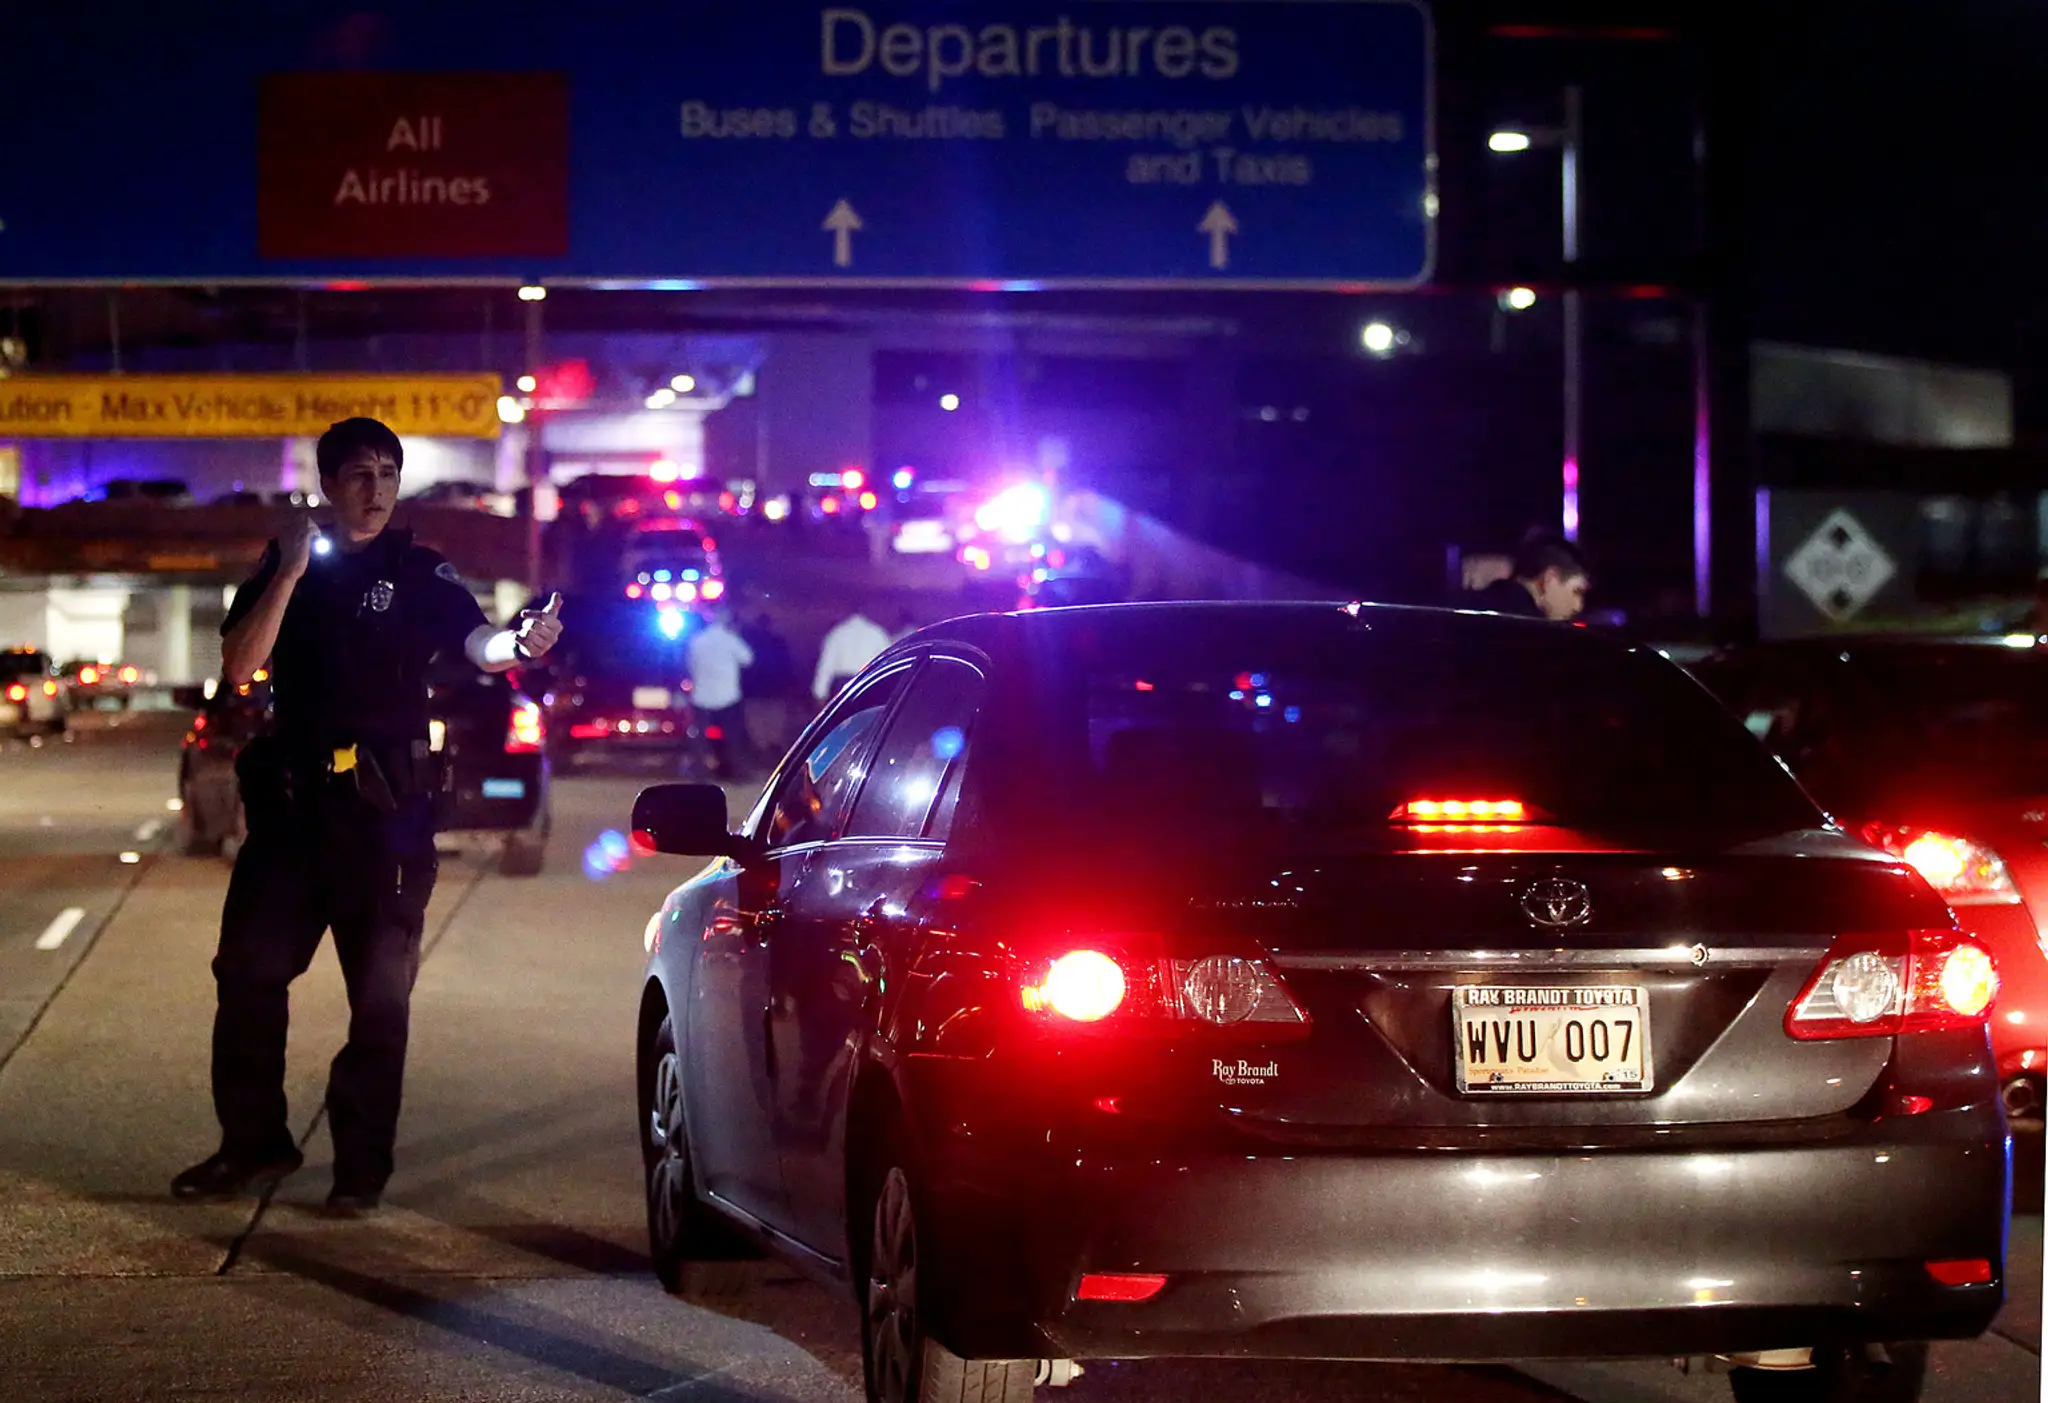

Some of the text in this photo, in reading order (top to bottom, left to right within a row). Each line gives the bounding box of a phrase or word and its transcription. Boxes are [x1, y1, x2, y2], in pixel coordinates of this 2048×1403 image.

[820, 8, 1240, 92] Departures
[386, 115, 442, 152] All
[680, 101, 1005, 139] Buses & Shuttles
[1030, 102, 1405, 149] Passenger Vehicles
[1126, 147, 1312, 186] and Taxis
[334, 167, 492, 206] Airlines
[101, 391, 166, 422] Max
[172, 390, 290, 423] Vehicle
[1468, 988, 1633, 1005] RAY BRANDT TOYOTA
[1466, 1020, 1633, 1063] WVU 007
[1212, 1058, 1279, 1081] Ray Brandt
